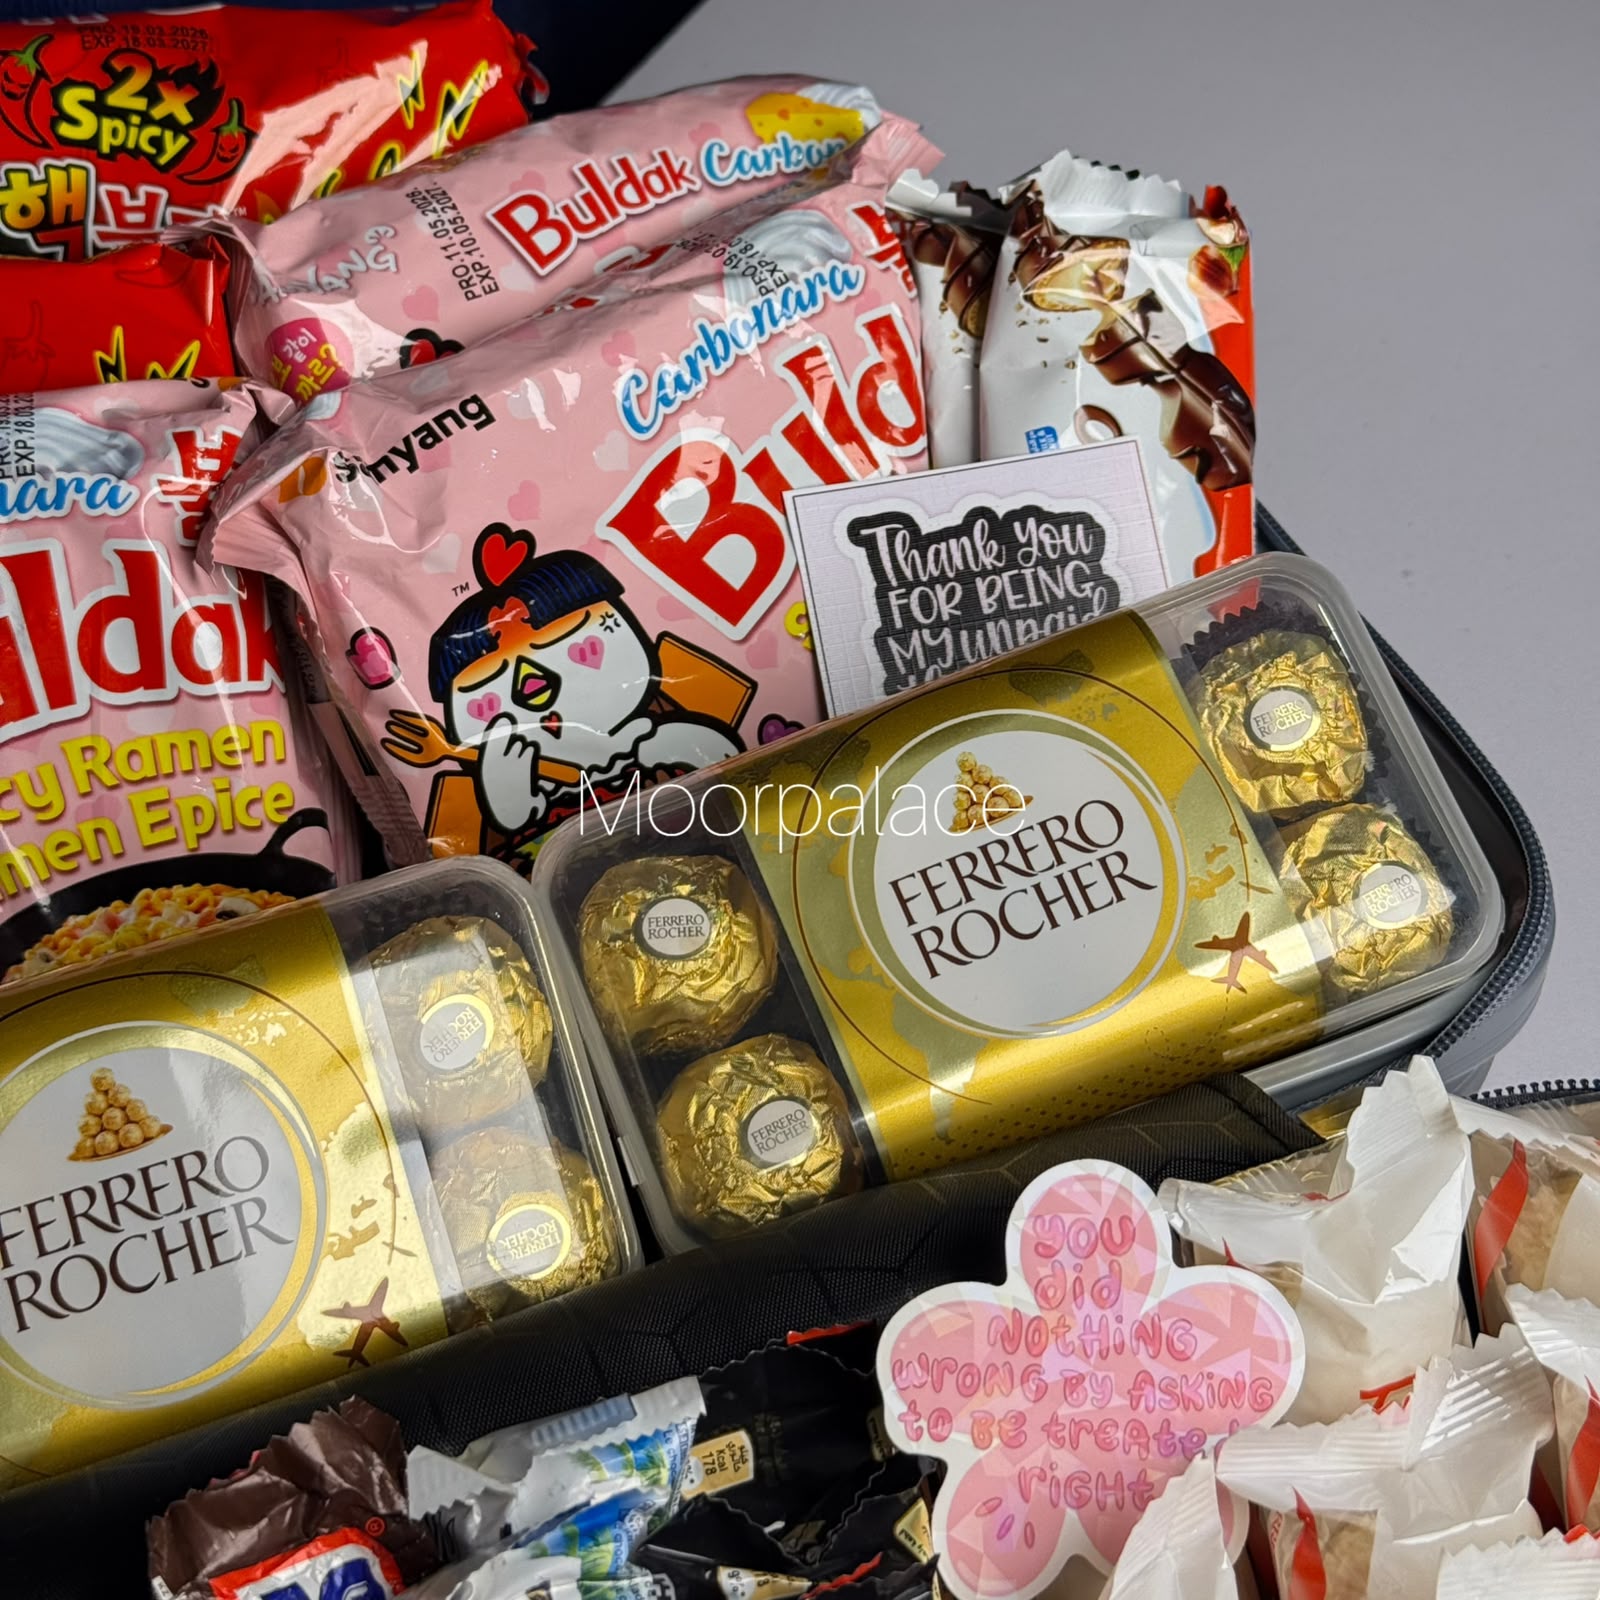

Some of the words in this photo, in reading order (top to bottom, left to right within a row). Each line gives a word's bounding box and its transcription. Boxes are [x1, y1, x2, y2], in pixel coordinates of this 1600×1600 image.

[57, 86, 190, 166] Spicy
[424, 182, 500, 297] EXP.10.05.2027.
[490, 149, 699, 273] Buldak
[620, 267, 861, 435] Carbonara
[860, 518, 1005, 587] Thank
[1013, 517, 1094, 567] you
[452, 582, 470, 597] TM
[888, 581, 962, 629] FOR
[976, 560, 1095, 615] BEING
[60, 720, 287, 795] Ramen
[128, 778, 295, 849] Epice
[889, 799, 1124, 927] FERRERO
[647, 914, 705, 928] FERRERO
[647, 925, 705, 940] ROCHER
[911, 850, 1158, 979] ROCHER
[751, 1109, 806, 1143] FERRERO
[757, 1120, 809, 1155] ROCHER
[0, 1136, 269, 1270] FERRERO
[4, 1197, 294, 1333] ROCHER
[1034, 1259, 1122, 1310] did
[701, 1452, 716, 1476] 178
